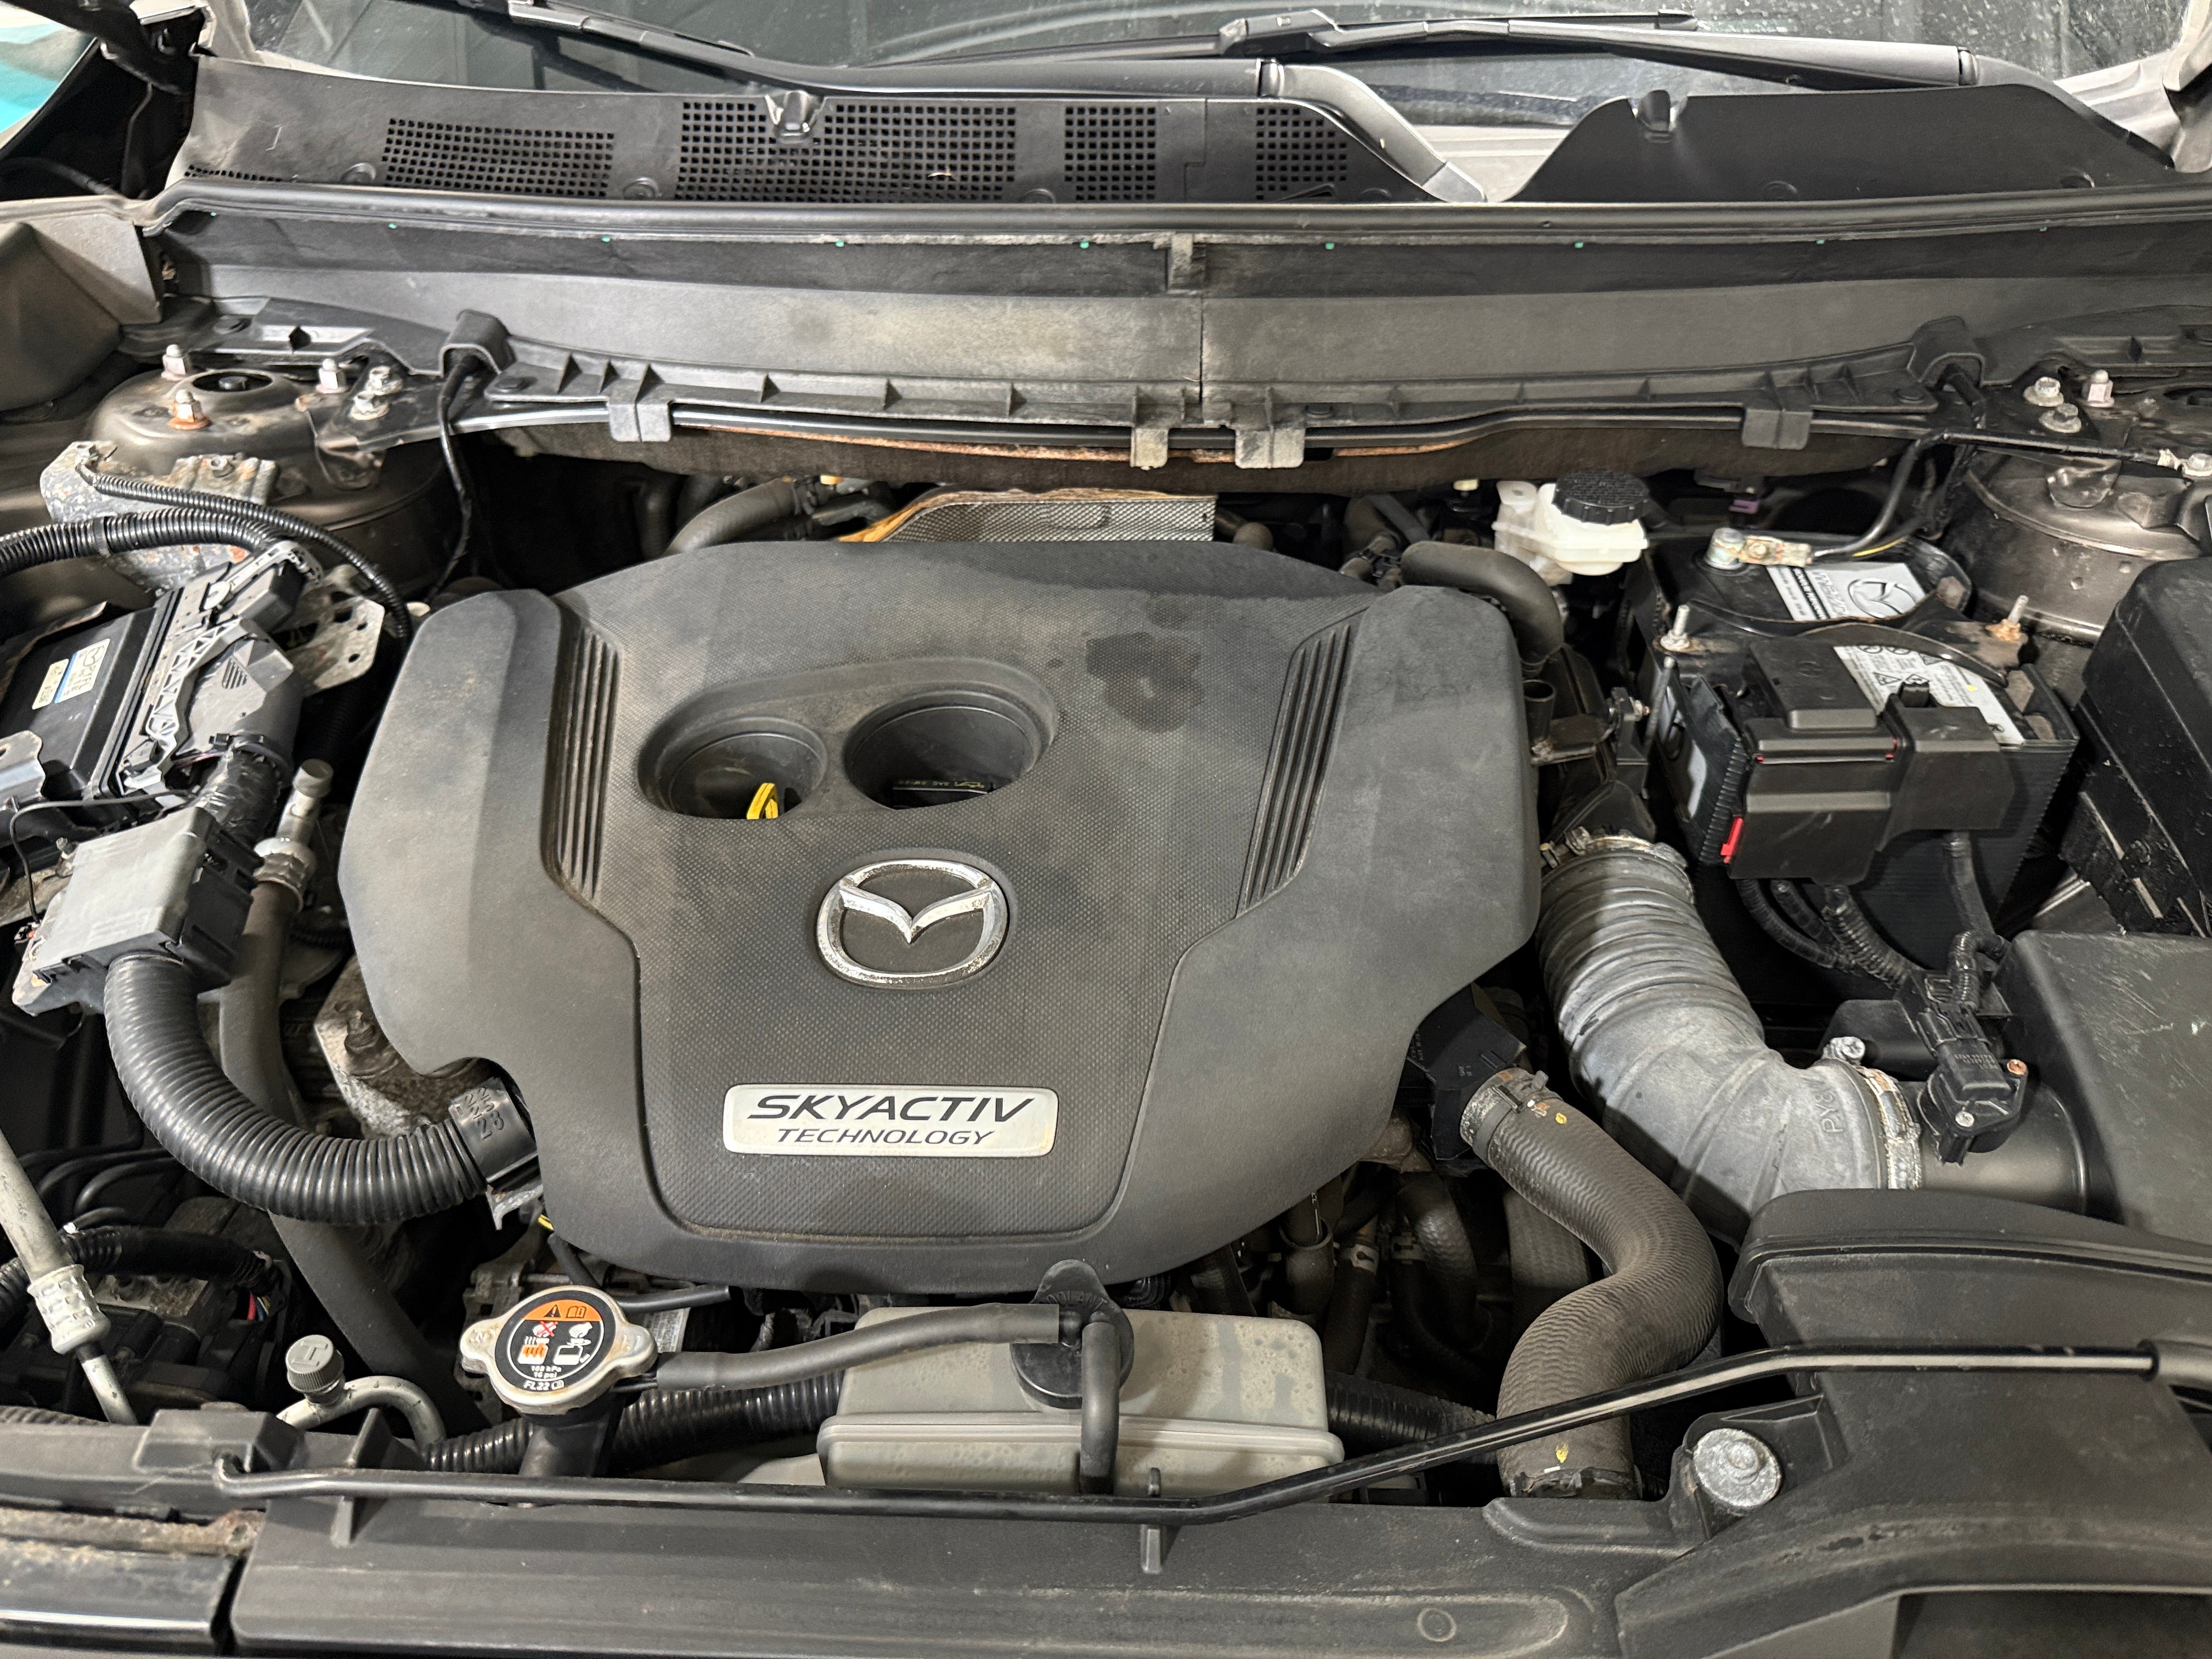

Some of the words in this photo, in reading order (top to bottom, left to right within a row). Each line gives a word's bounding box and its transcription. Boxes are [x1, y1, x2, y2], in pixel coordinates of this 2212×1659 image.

[747, 1094, 1035, 1122] SKYACTIV
[777, 1128, 996, 1146] TECHNOLOGY
[1046, 1290, 1107, 1312] OOLANT
[523, 1380, 550, 1390] FL22
